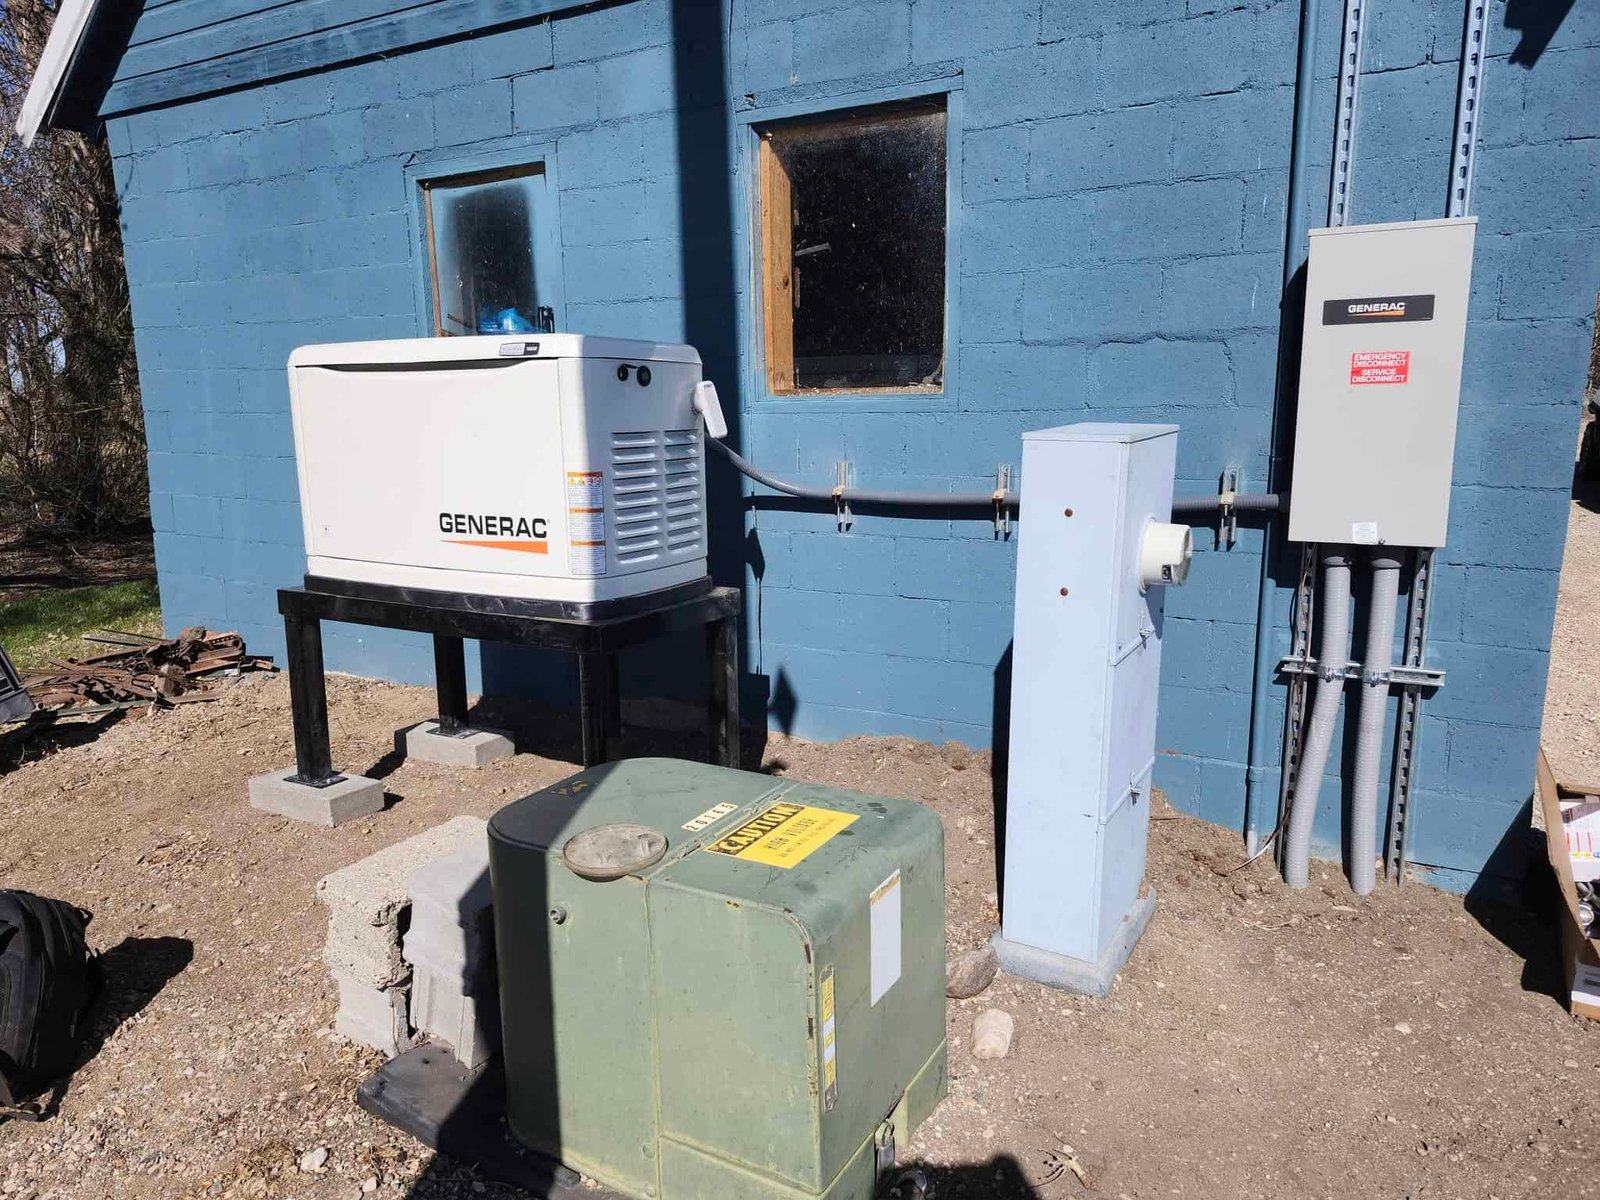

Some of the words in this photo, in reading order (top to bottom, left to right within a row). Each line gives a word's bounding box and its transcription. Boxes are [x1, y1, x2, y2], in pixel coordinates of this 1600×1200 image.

[1347, 302, 1406, 313] GENERAC
[1354, 353, 1407, 361] EMERGENCY
[1353, 360, 1406, 368] DISCONNECT
[1362, 368, 1397, 376] SERVICE
[1352, 374, 1405, 383] DISCONNECT
[439, 512, 547, 539] GENERAC
[717, 804, 799, 852] CAUTION
